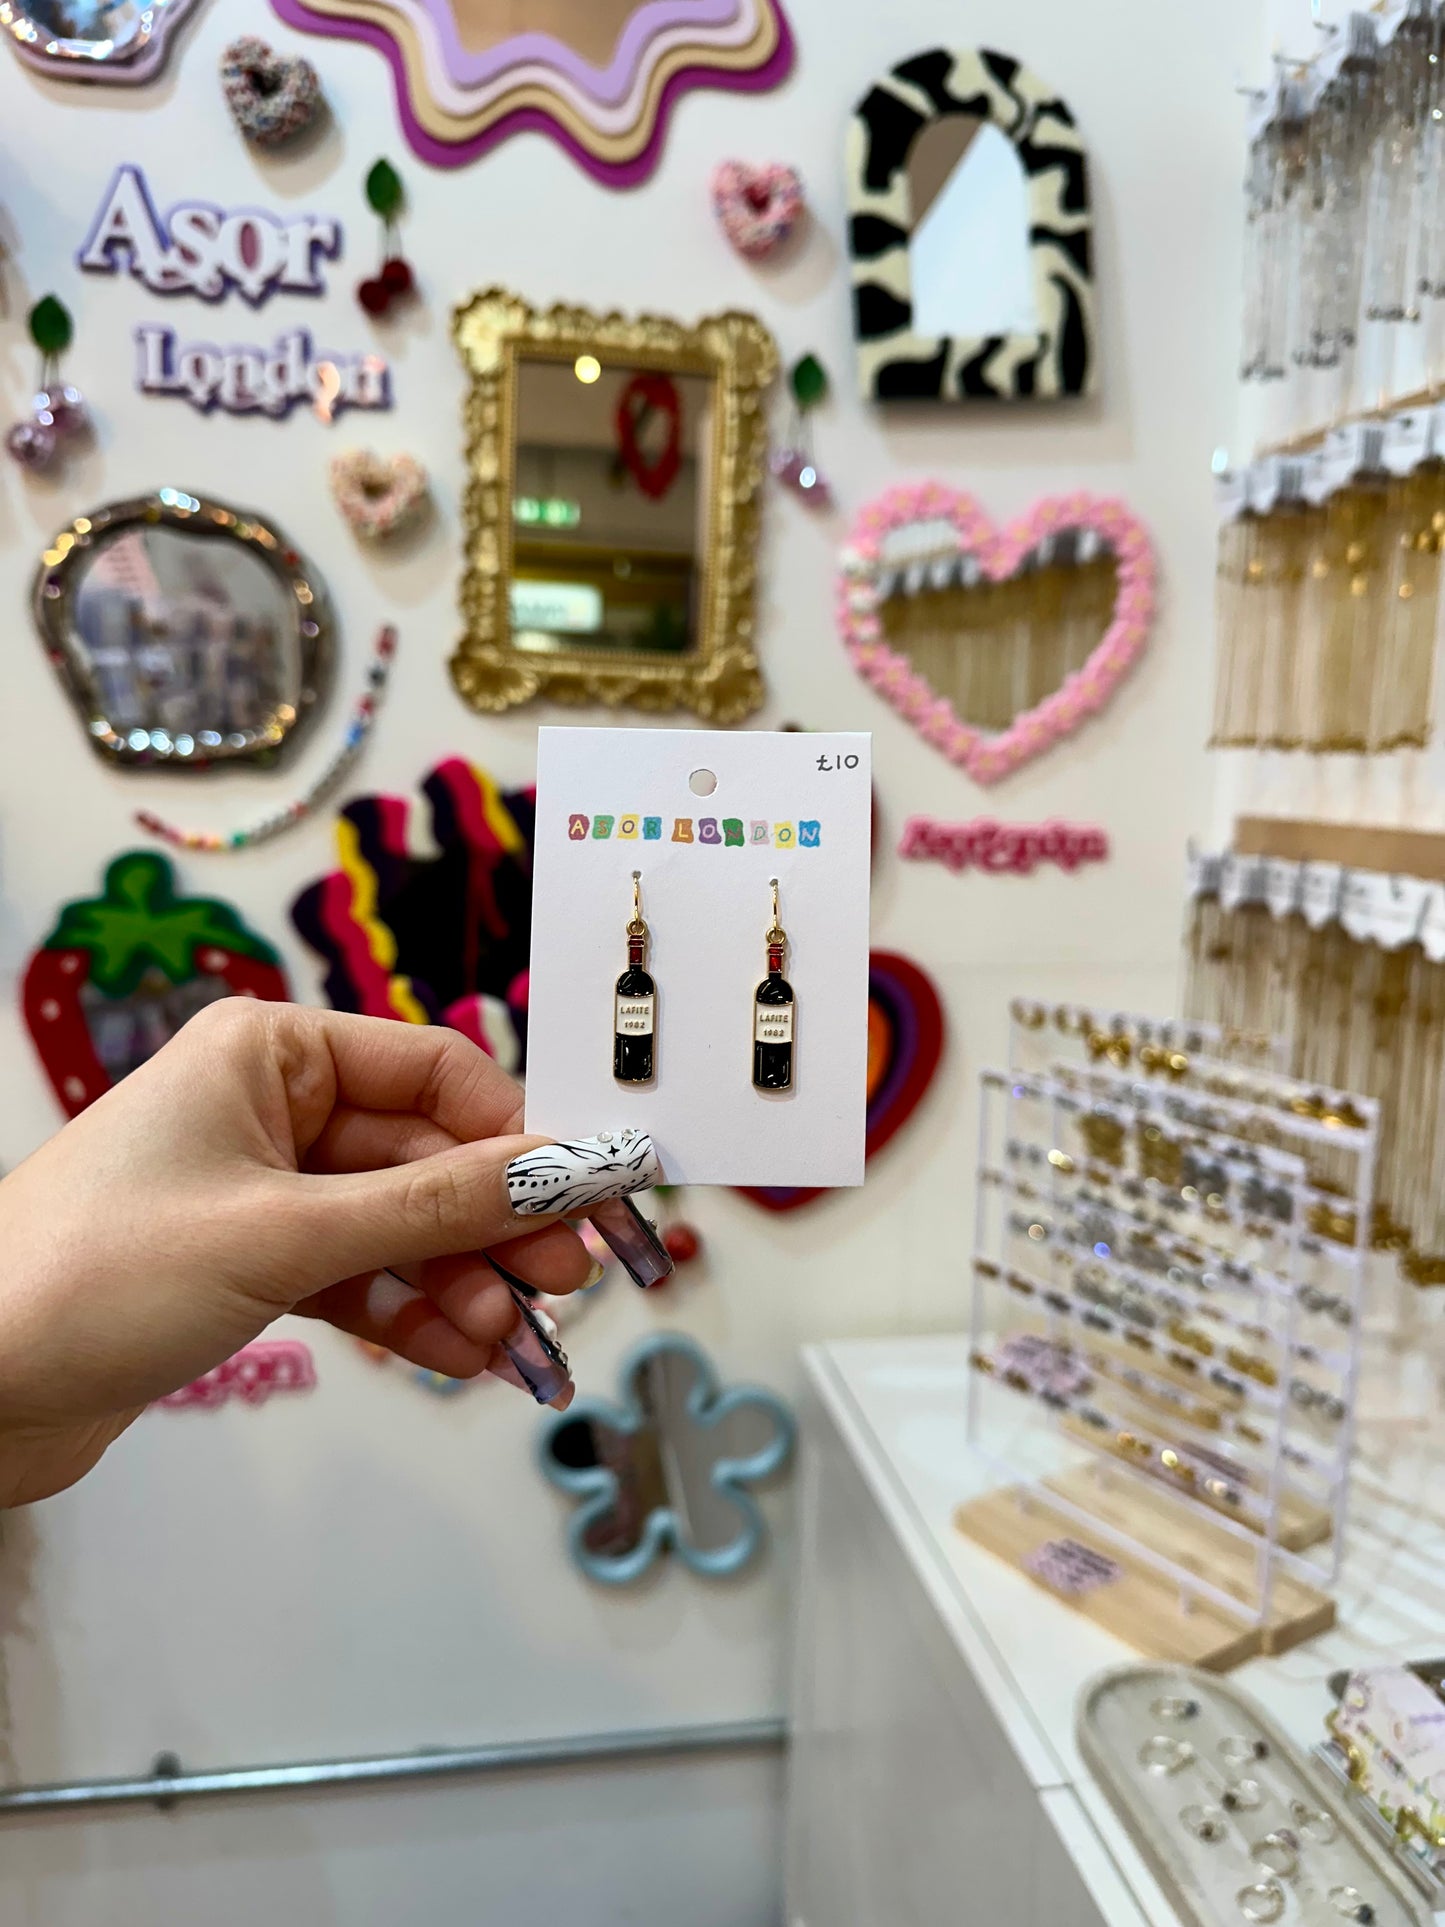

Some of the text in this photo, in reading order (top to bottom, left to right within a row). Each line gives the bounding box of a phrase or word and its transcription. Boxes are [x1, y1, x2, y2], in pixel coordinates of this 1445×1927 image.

[78, 165, 342, 306] Asor
[135, 325, 394, 421] London
[816, 754, 860, 772] £10
[569, 814, 821, 848] ASOR LONDON
[619, 1005, 651, 1015] LAFITE
[624, 1020, 646, 1029] 1982
[759, 1013, 789, 1023] LAFITE
[763, 1028, 785, 1037] 1982
